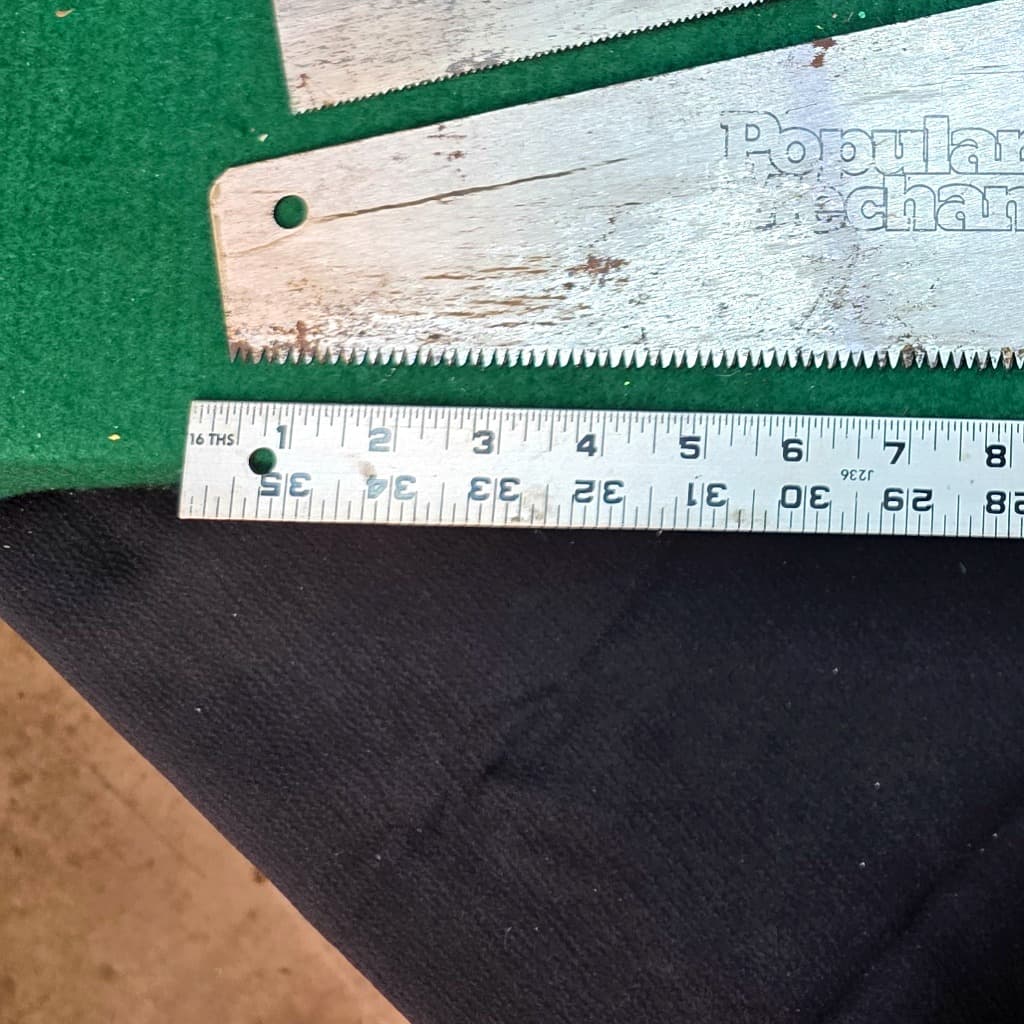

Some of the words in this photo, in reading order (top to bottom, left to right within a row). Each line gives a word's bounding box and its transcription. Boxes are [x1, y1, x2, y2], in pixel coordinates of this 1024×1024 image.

[190, 433, 206, 446] 16
[209, 433, 235, 446] THS
[274, 425, 288, 449] 1
[368, 428, 391, 453] 2
[472, 430, 495, 455] 3
[577, 434, 598, 456] 4
[680, 437, 701, 460] 5
[782, 439, 803, 462] 6
[883, 442, 905, 465] 7
[985, 444, 1007, 468] 8
[260, 472, 312, 498] 35
[367, 474, 417, 501] 34
[470, 478, 520, 501] 33
[576, 480, 625, 504] 32
[687, 483, 727, 507] 31
[781, 485, 830, 509] 30
[883, 489, 933, 512] 29
